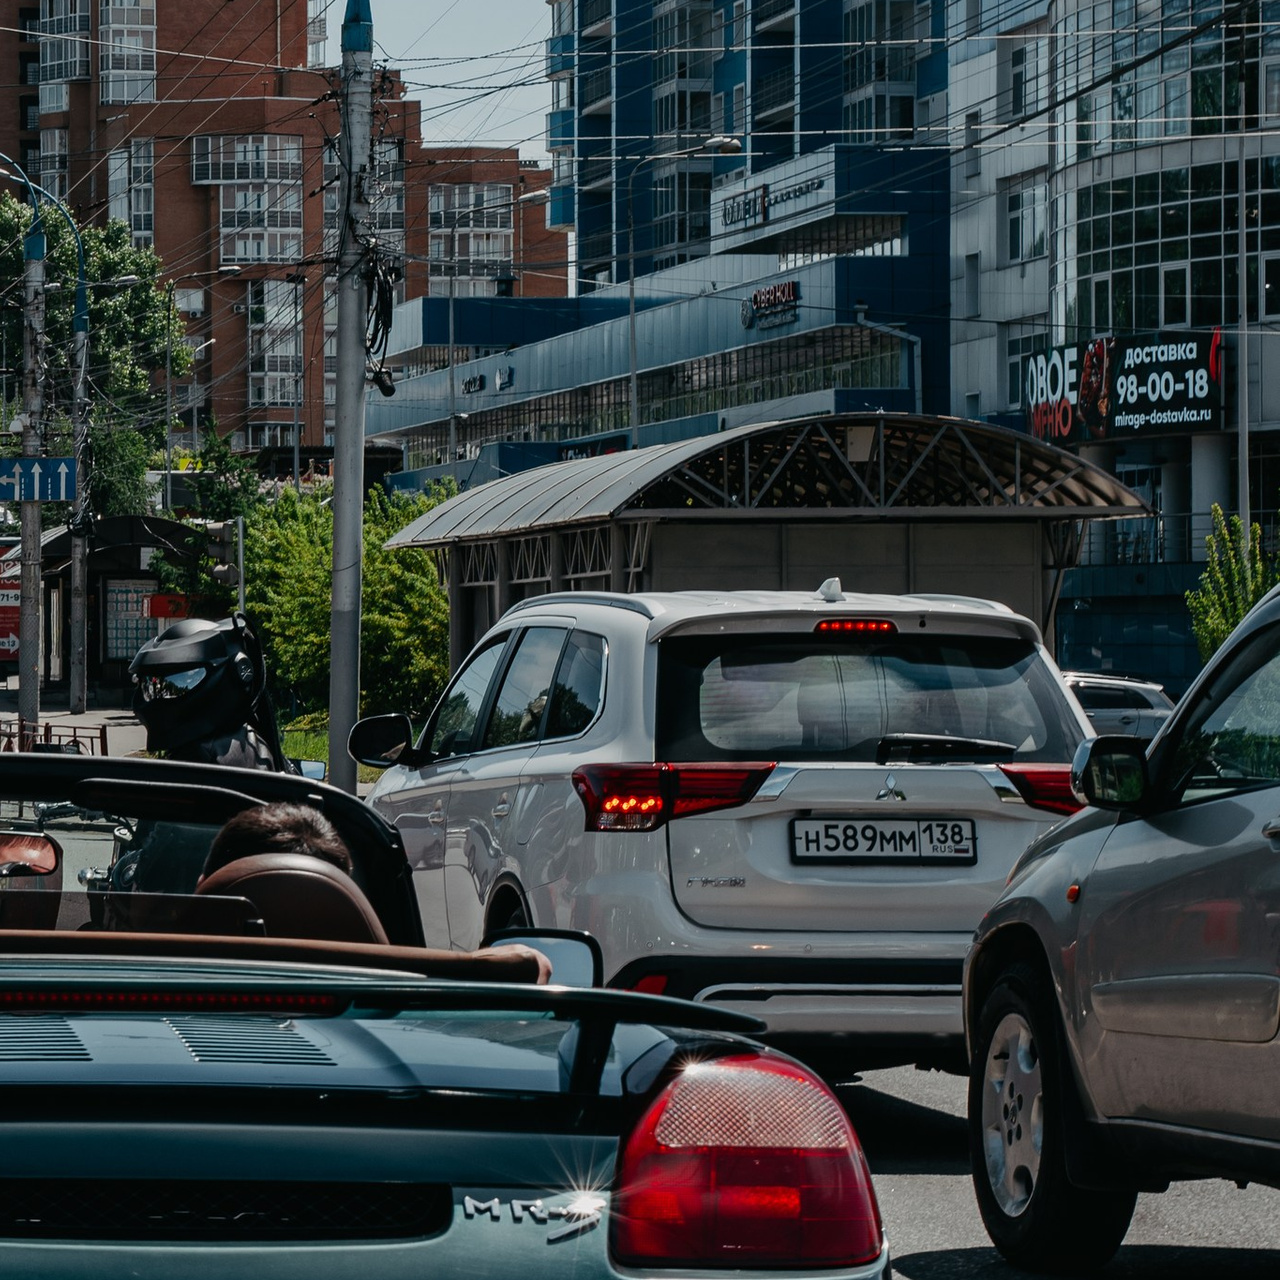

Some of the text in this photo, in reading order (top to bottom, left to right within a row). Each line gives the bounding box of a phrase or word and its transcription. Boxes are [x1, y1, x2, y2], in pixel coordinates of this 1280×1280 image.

[1124, 341, 1198, 369] доставка
[1026, 347, 1078, 413] ОВОЕ
[1116, 368, 1209, 405] 98-00-18
[1114, 406, 1212, 428] mirage-dostavka.ru
[7, 640, 16, 648] 13
[804, 823, 964, 852] Н589ММ 138
[931, 845, 954, 854] RUS
